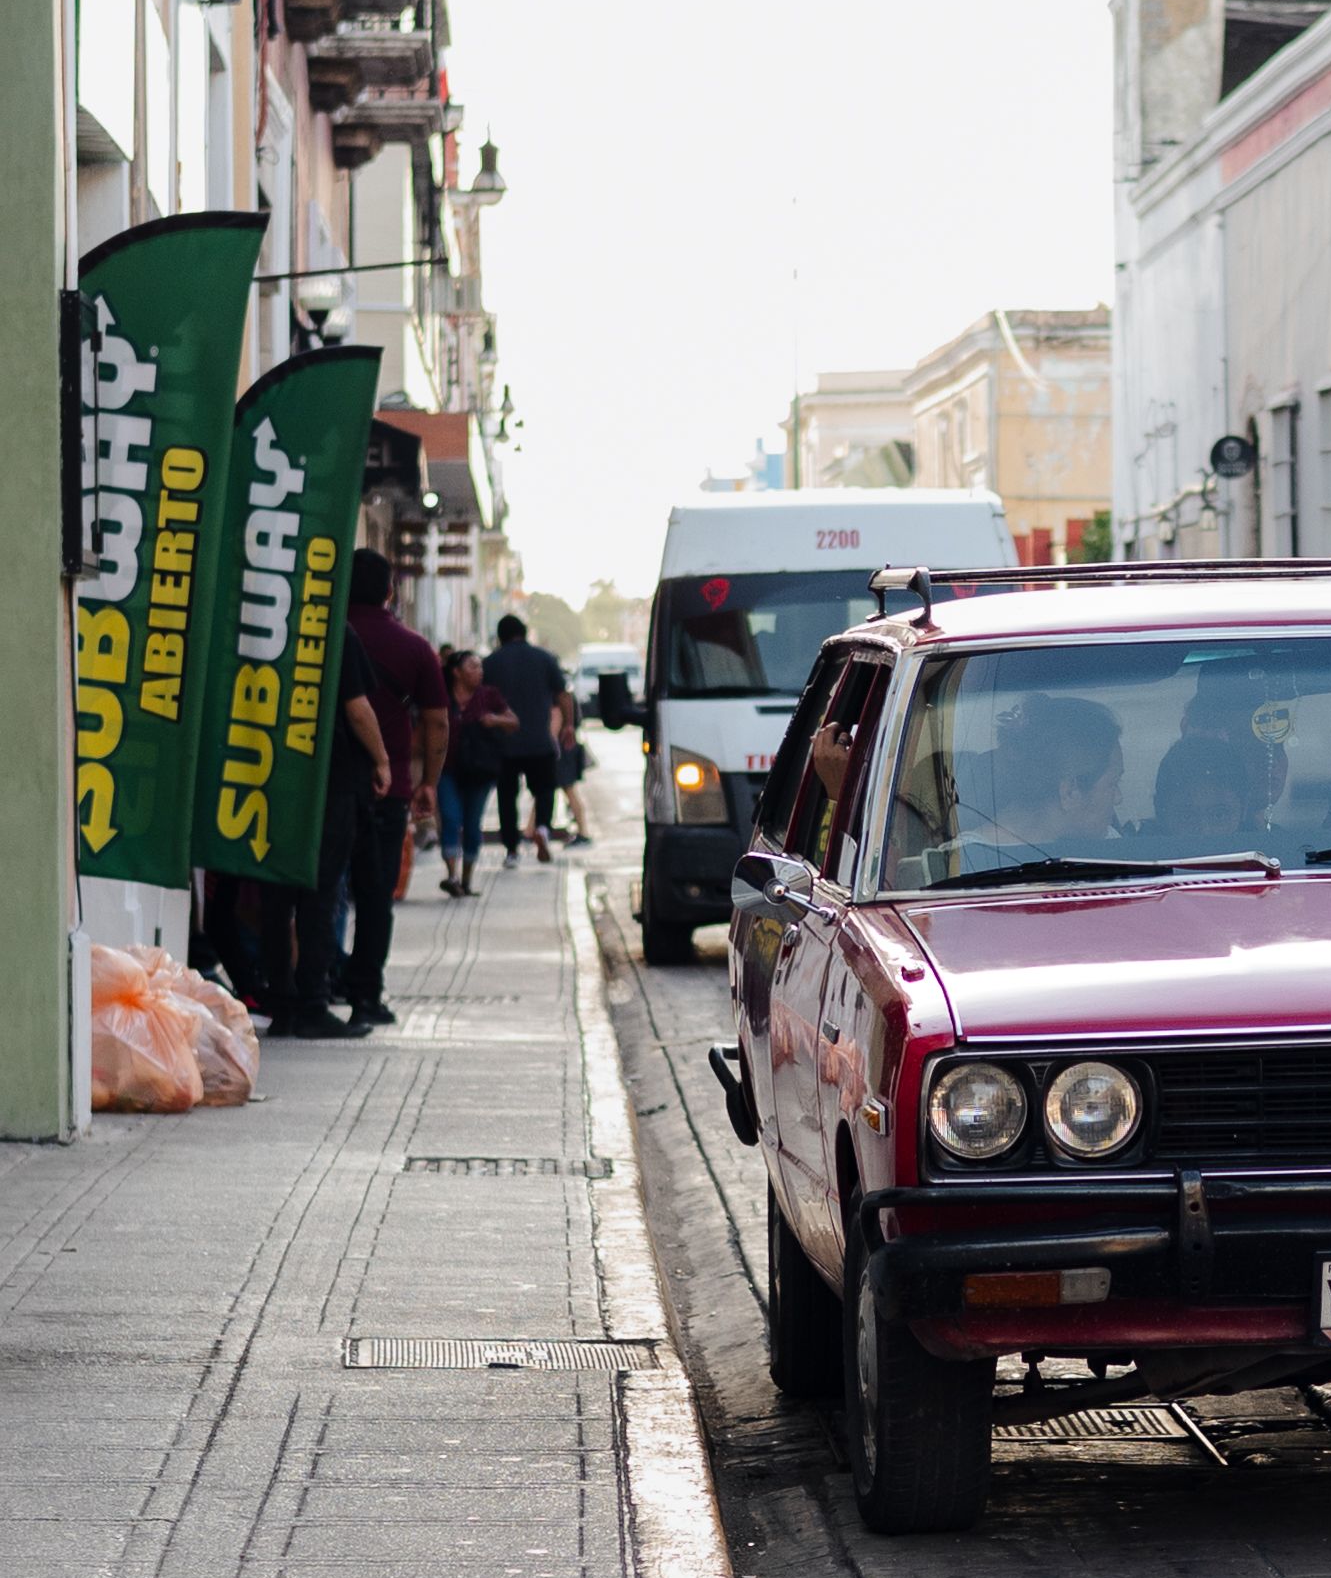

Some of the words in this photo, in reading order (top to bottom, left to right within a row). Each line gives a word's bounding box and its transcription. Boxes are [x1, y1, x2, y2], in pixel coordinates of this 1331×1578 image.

[139, 447, 206, 722] ABIERTO
[216, 416, 306, 864] SUBWAY
[285, 536, 336, 756] ABIERTO
[815, 530, 860, 550] 2200
